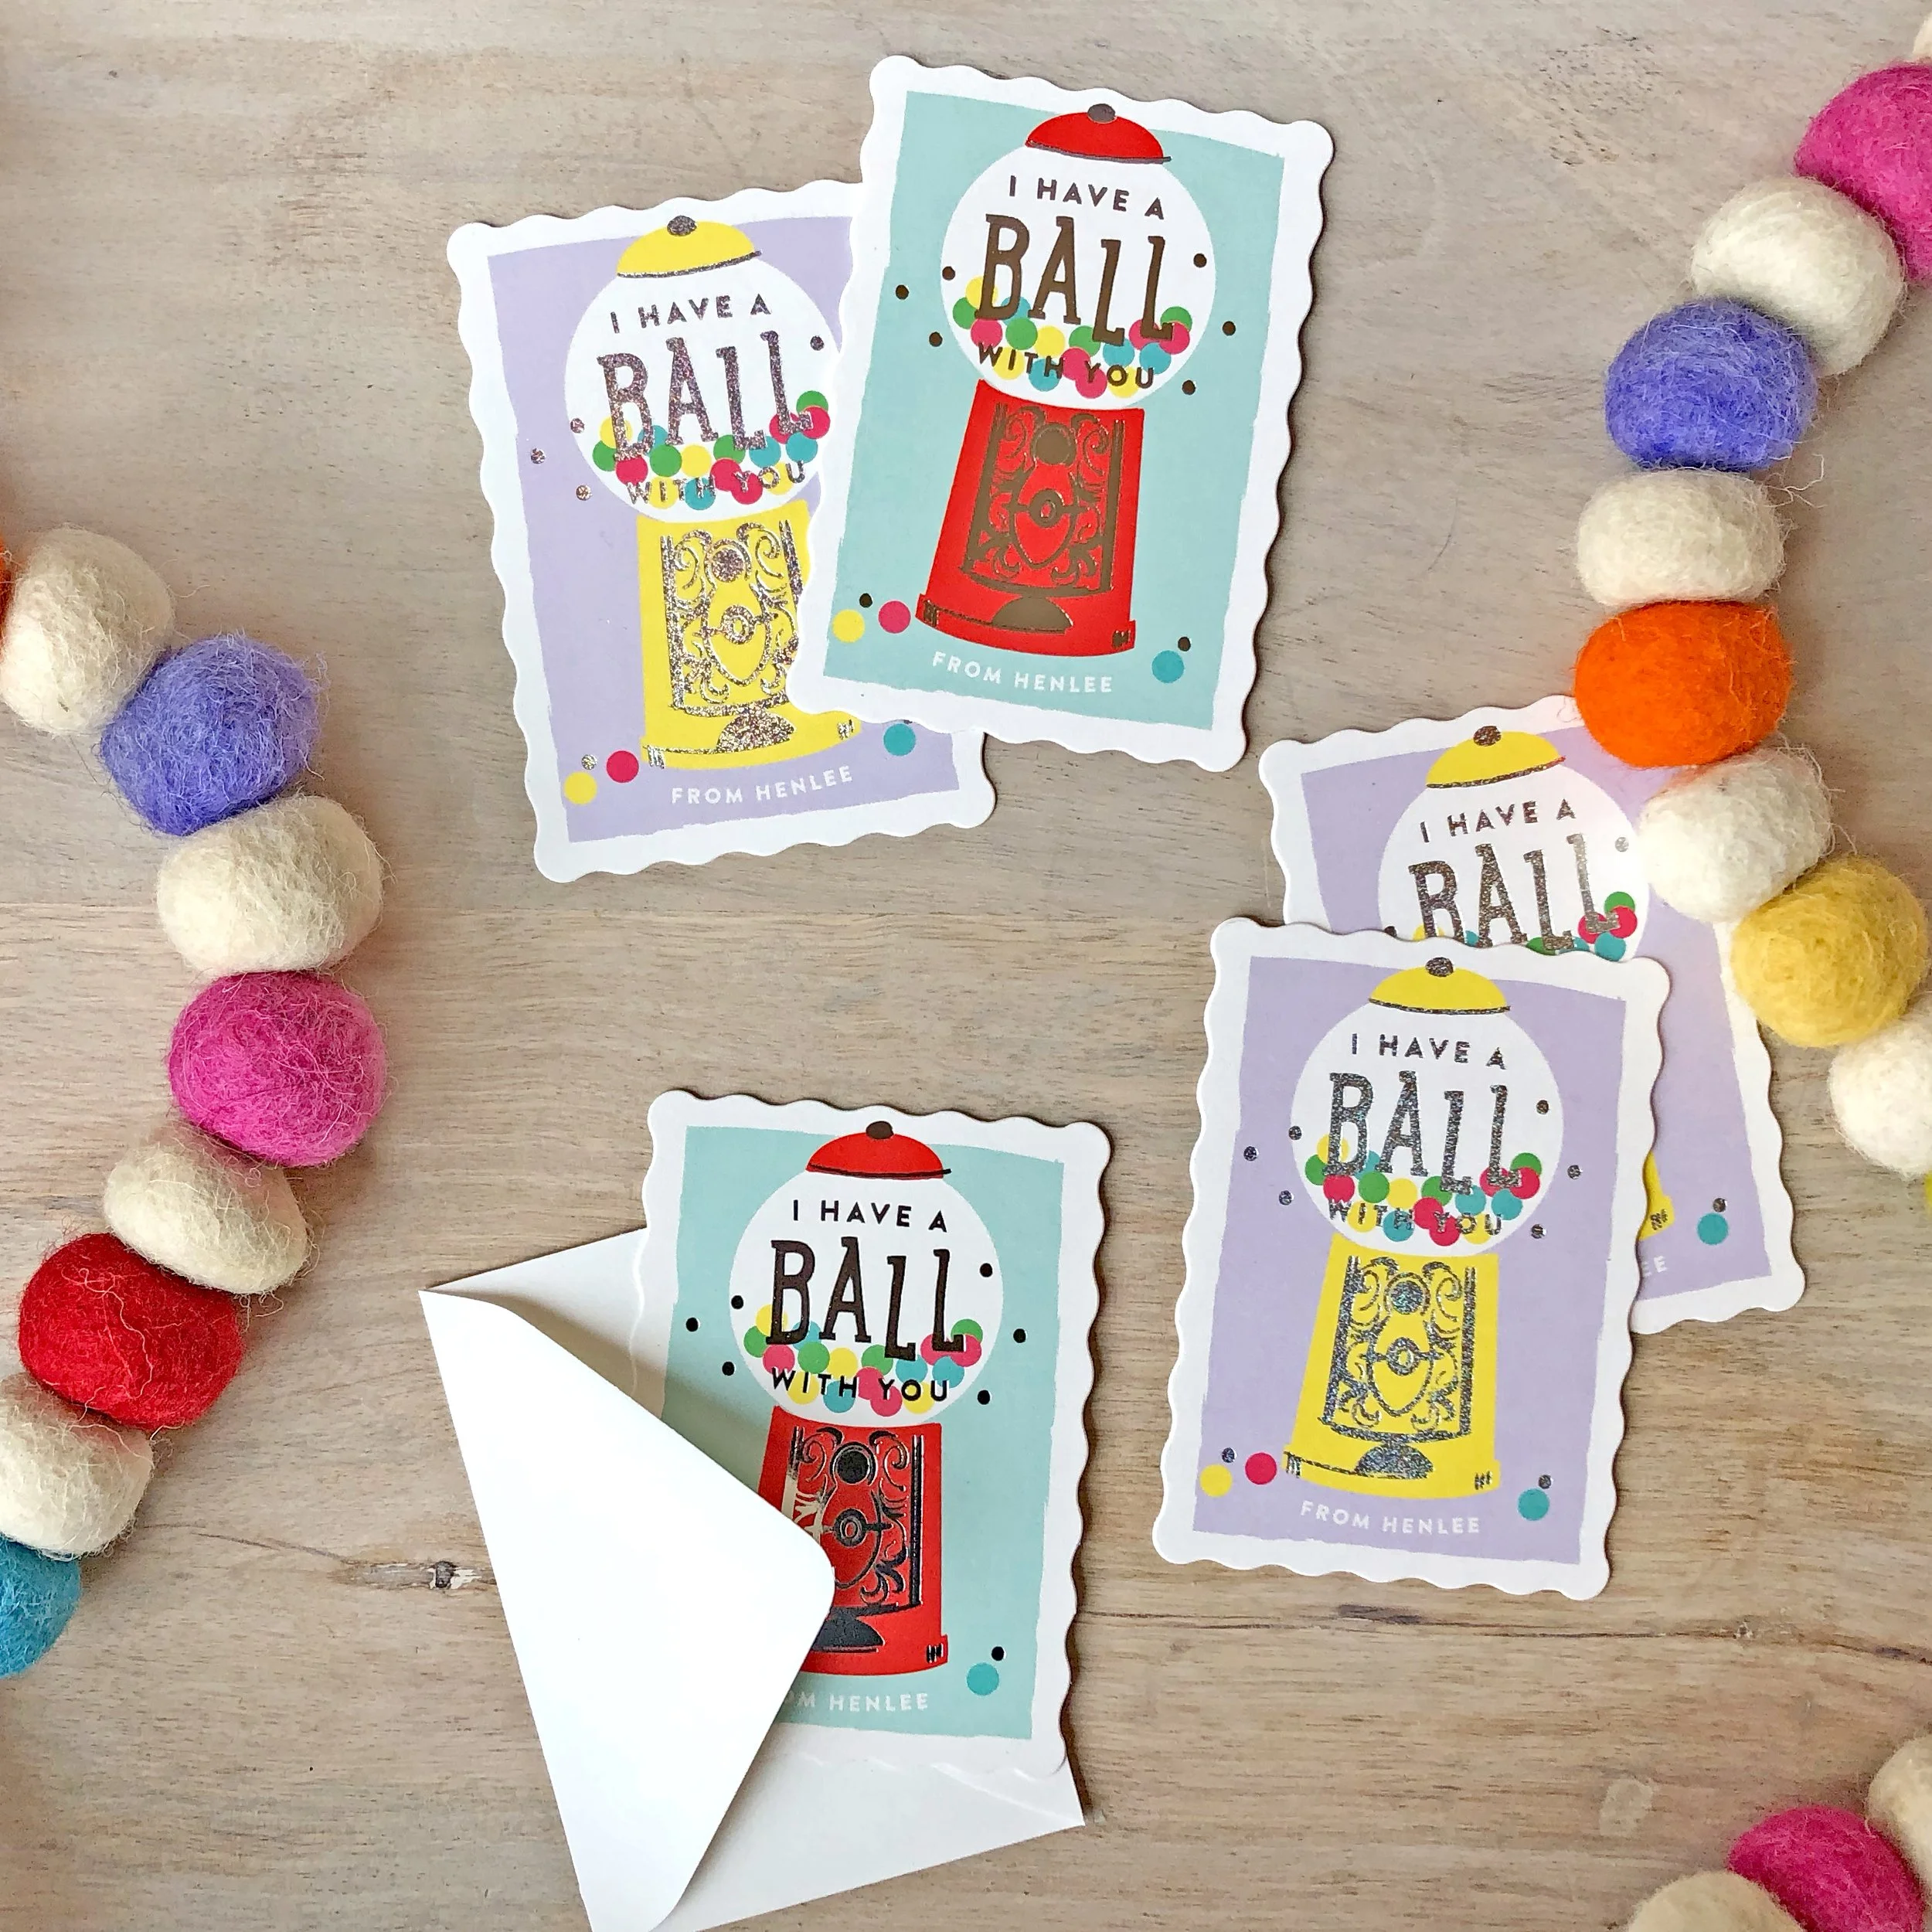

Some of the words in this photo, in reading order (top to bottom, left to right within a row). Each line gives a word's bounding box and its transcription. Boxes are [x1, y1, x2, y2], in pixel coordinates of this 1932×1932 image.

[1009, 175, 1016, 197] I
[1037, 178, 1130, 212] HAVE
[1145, 198, 1165, 219] A
[975, 213, 1173, 346] BALL
[611, 311, 620, 334] I
[638, 294, 733, 328] HAVE
[750, 294, 772, 316] A
[978, 342, 1064, 379] WITH
[1083, 360, 1155, 388] YOU
[596, 330, 813, 461] BALL
[626, 475, 717, 504] WITH
[733, 459, 805, 493] YOU
[932, 651, 1002, 685] FROM
[1014, 671, 1113, 693] HENLEE
[671, 787, 743, 805] FROM
[755, 765, 853, 801] HENLEE
[1420, 821, 1430, 844] I
[1447, 801, 1539, 837] HAVE
[1555, 798, 1577, 821] A
[1351, 1032, 1359, 1056] I
[1379, 1033, 1471, 1064] HAVE
[1485, 1046, 1507, 1070] A
[1322, 1070, 1522, 1196] BALL
[793, 1199, 799, 1221] I
[820, 1200, 912, 1227] HAVE
[927, 1210, 947, 1233] A
[1328, 1198, 1415, 1231] WITH
[1433, 1210, 1502, 1236] YOU
[765, 1236, 964, 1362] BALL
[771, 1366, 859, 1400] WITH
[878, 1377, 948, 1402] YOU
[1301, 1500, 1369, 1530] FROM
[1382, 1515, 1481, 1535] HENLEE
[828, 1692, 928, 1713] HENLEE
